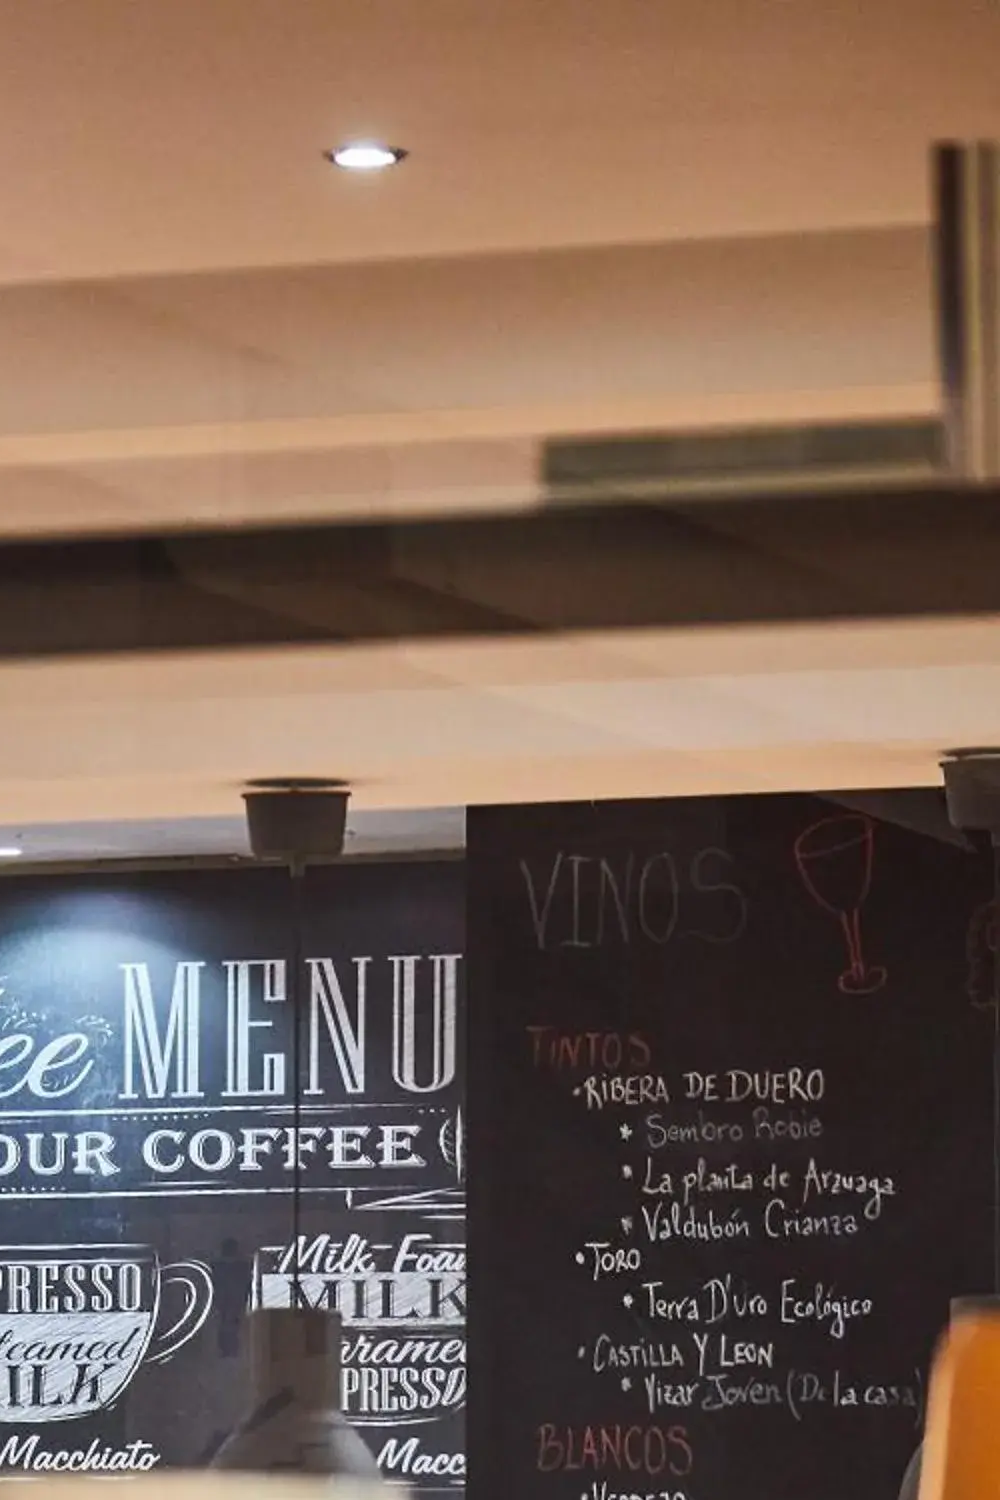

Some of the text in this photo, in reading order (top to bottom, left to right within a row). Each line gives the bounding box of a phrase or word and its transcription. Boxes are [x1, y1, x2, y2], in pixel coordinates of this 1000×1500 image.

[518, 848, 750, 950] VINOS
[118, 954, 464, 1099] MENU
[584, 1068, 825, 1109] RIBERA DE DUERO
[142, 1124, 427, 1174] COFFEE
[642, 1156, 673, 1194] La
[763, 1163, 790, 1191] de
[803, 1157, 896, 1220] Arzuaga
[641, 1198, 859, 1242] Valdubón Crianza
[279, 1233, 376, 1275] Milk
[584, 1242, 642, 1281] TORO
[641, 1282, 700, 1320] Terra
[593, 1333, 685, 1373] CASTILLA
[693, 1332, 709, 1376] Y
[341, 1366, 466, 1412] PRESSO
[700, 1373, 781, 1411] Joven
[376, 1437, 466, 1475] Macc
[537, 1423, 693, 1476] BLANCOS
